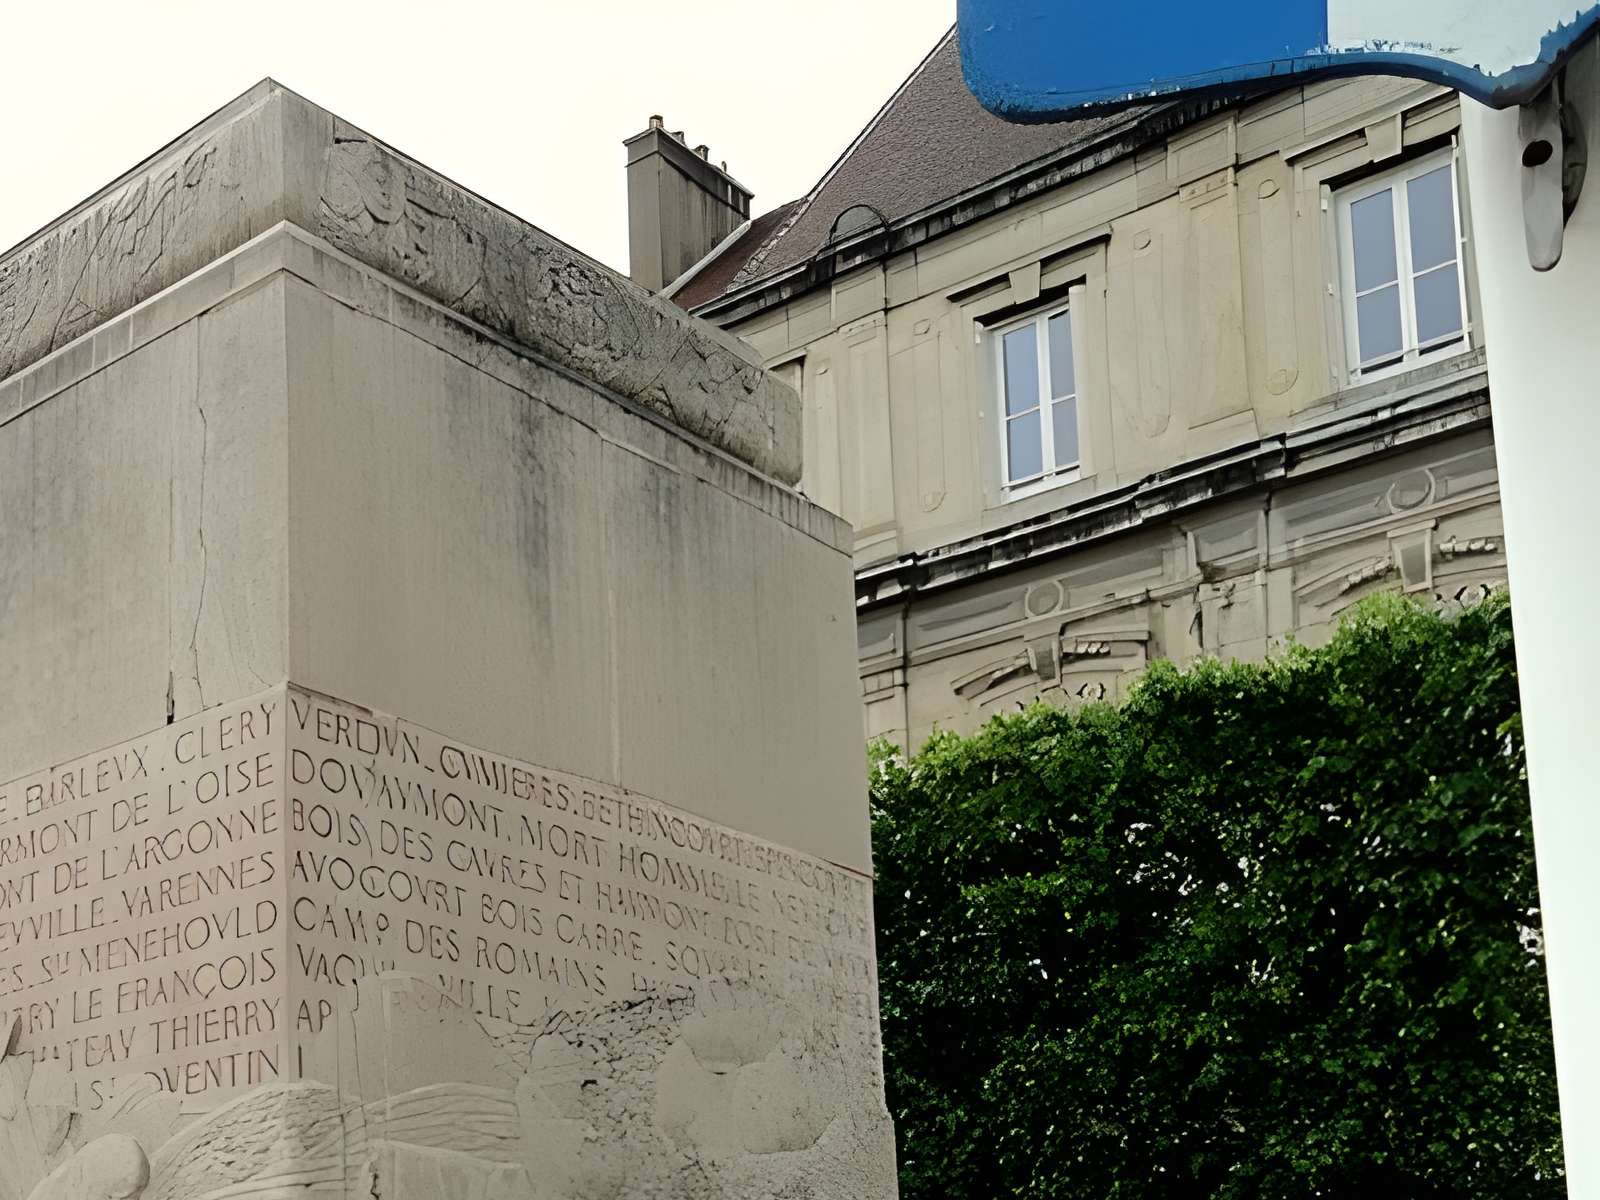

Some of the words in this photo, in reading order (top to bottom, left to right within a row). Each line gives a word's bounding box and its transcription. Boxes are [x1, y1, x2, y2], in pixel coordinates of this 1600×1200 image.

[175, 703, 277, 764] CLERY
[113, 793, 148, 832] DE
[168, 752, 274, 815] L'OISE
[54, 856, 88, 894] DE
[102, 799, 278, 880] L'ARGONNE
[292, 798, 361, 846] BOIS
[380, 819, 433, 862] DES
[560, 870, 584, 904] ET
[521, 815, 606, 867] MORT
[122, 851, 276, 918] VARENNES
[293, 851, 466, 917] AVOCOVRT
[481, 893, 543, 935] BOIS
[80, 900, 277, 976] MENEHOVLD
[405, 919, 460, 962] DES
[476, 936, 607, 996] ROMAINS
[73, 988, 102, 1024] LE
[149, 998, 280, 1054] THIERRY
